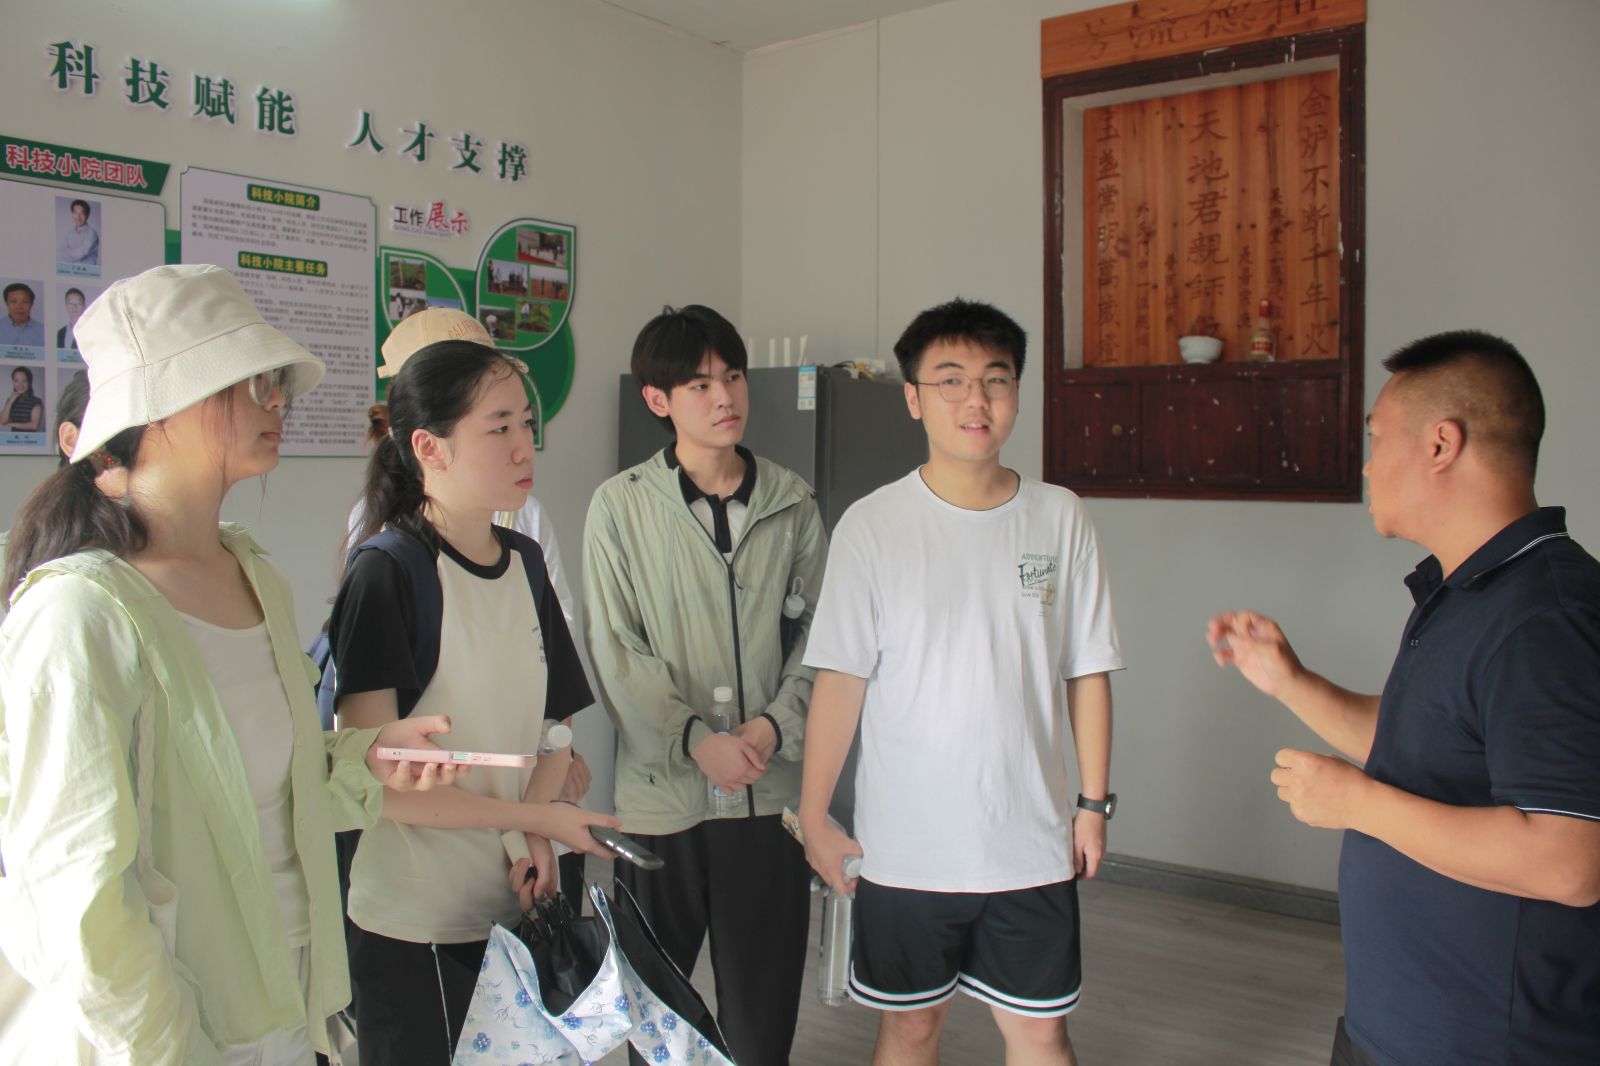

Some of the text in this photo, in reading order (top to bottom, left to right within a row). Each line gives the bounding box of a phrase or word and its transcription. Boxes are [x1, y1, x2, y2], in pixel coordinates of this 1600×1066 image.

[48, 40, 528, 182] 科技赋能 人才支撑
[6, 144, 149, 189] 科技小院团队
[250, 186, 317, 209] 科技小院简介
[393, 201, 469, 235] 工作展示
[240, 253, 326, 275] 科技小院主要任务
